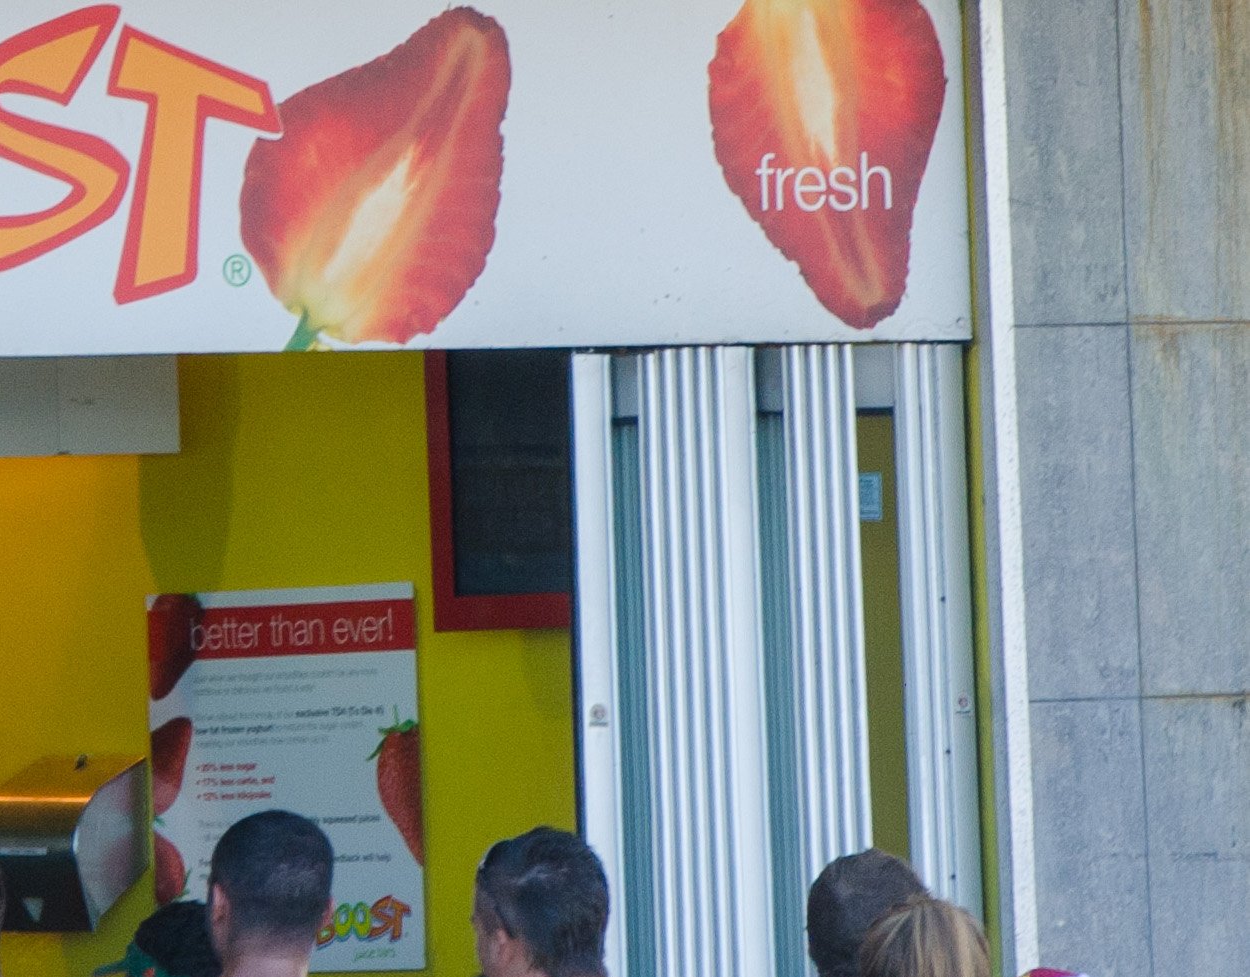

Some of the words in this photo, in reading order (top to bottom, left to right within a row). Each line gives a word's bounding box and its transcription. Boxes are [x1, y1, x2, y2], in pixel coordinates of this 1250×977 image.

[755, 151, 892, 212] fresh
[190, 615, 262, 651] better
[270, 613, 325, 648] than
[332, 607, 393, 645] ever!
